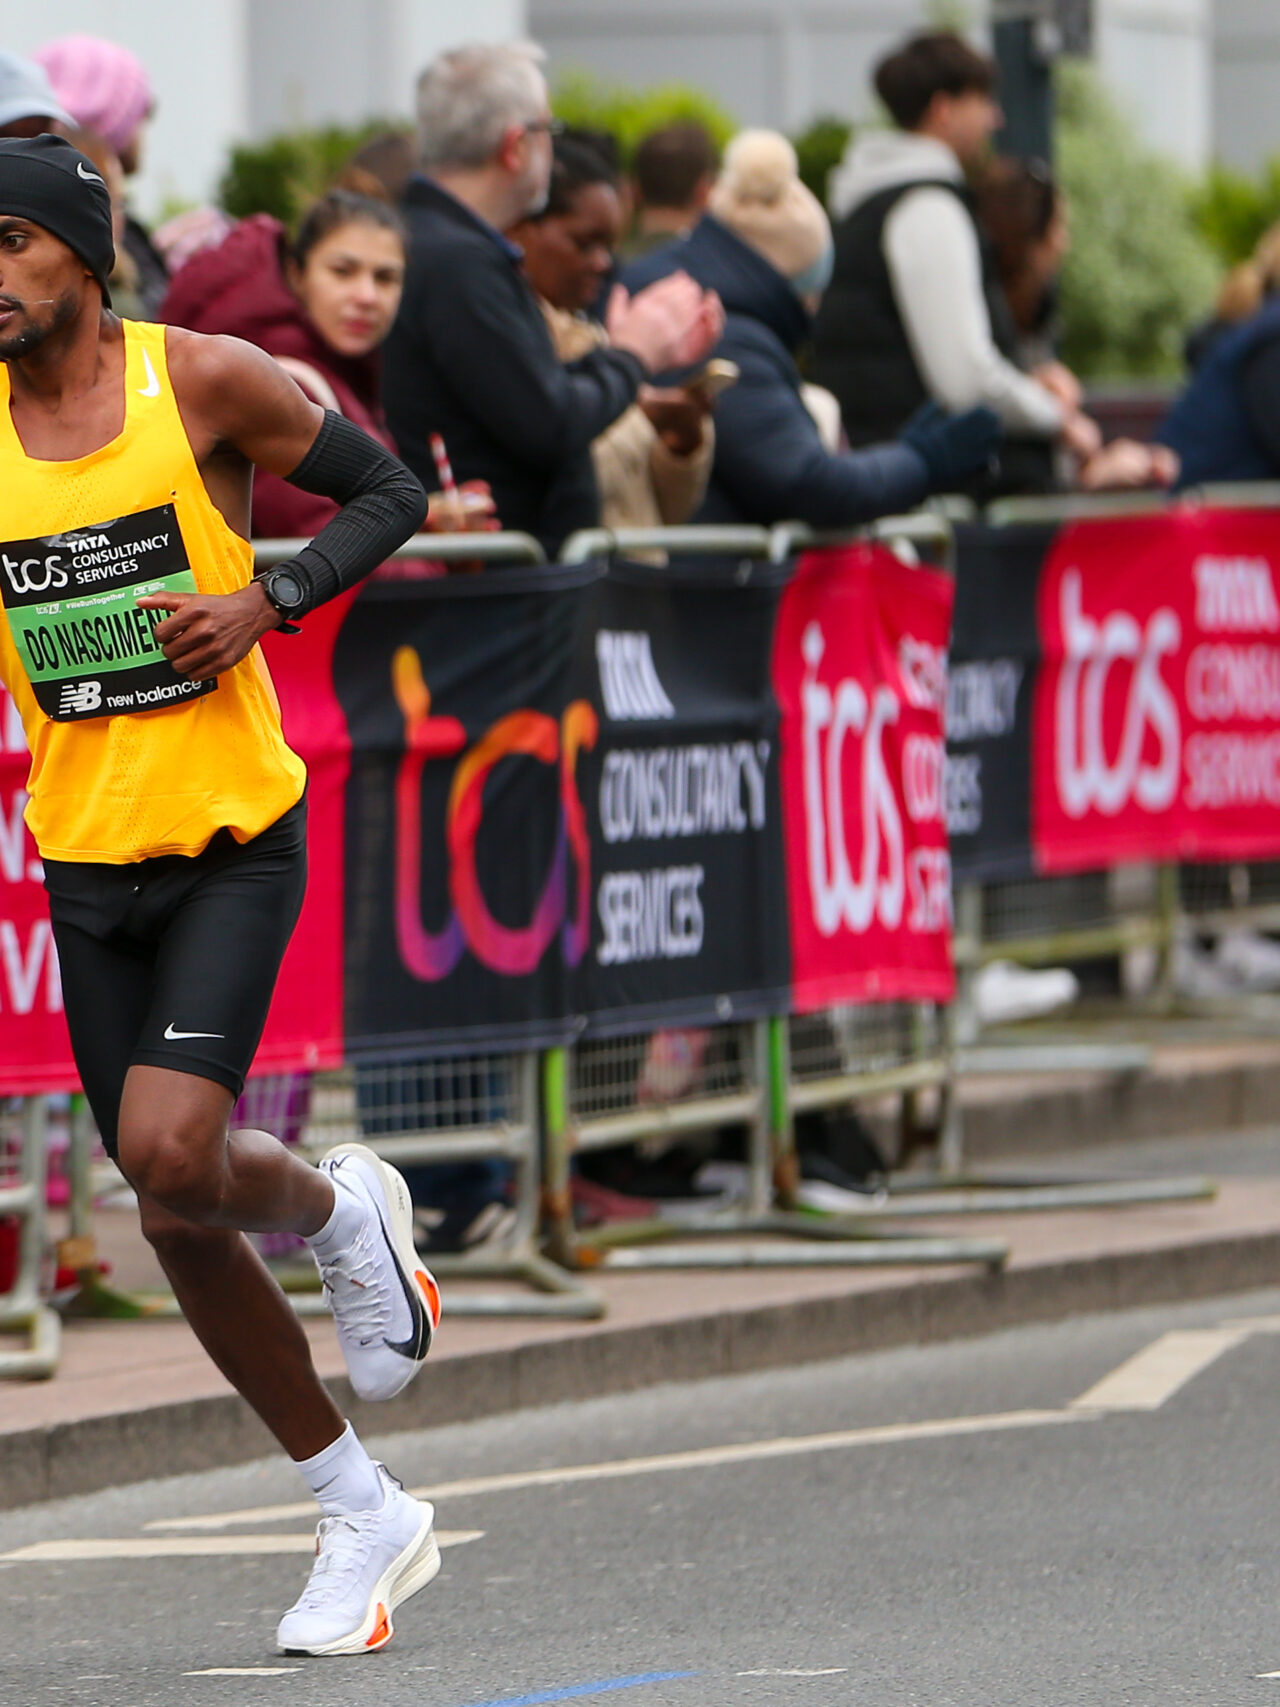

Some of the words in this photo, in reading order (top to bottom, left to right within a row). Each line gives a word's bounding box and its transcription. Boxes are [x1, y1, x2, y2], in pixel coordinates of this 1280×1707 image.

[66, 533, 111, 554] TATA
[71, 533, 170, 569] CONSULTANCY
[1, 553, 69, 594] tcs
[74, 559, 139, 585] SERVICES
[23, 625, 60, 672] DO
[105, 693, 134, 708] new
[135, 681, 202, 705] balance
[1057, 564, 1182, 820] tcs
[598, 739, 771, 844] CONSULTANCY
